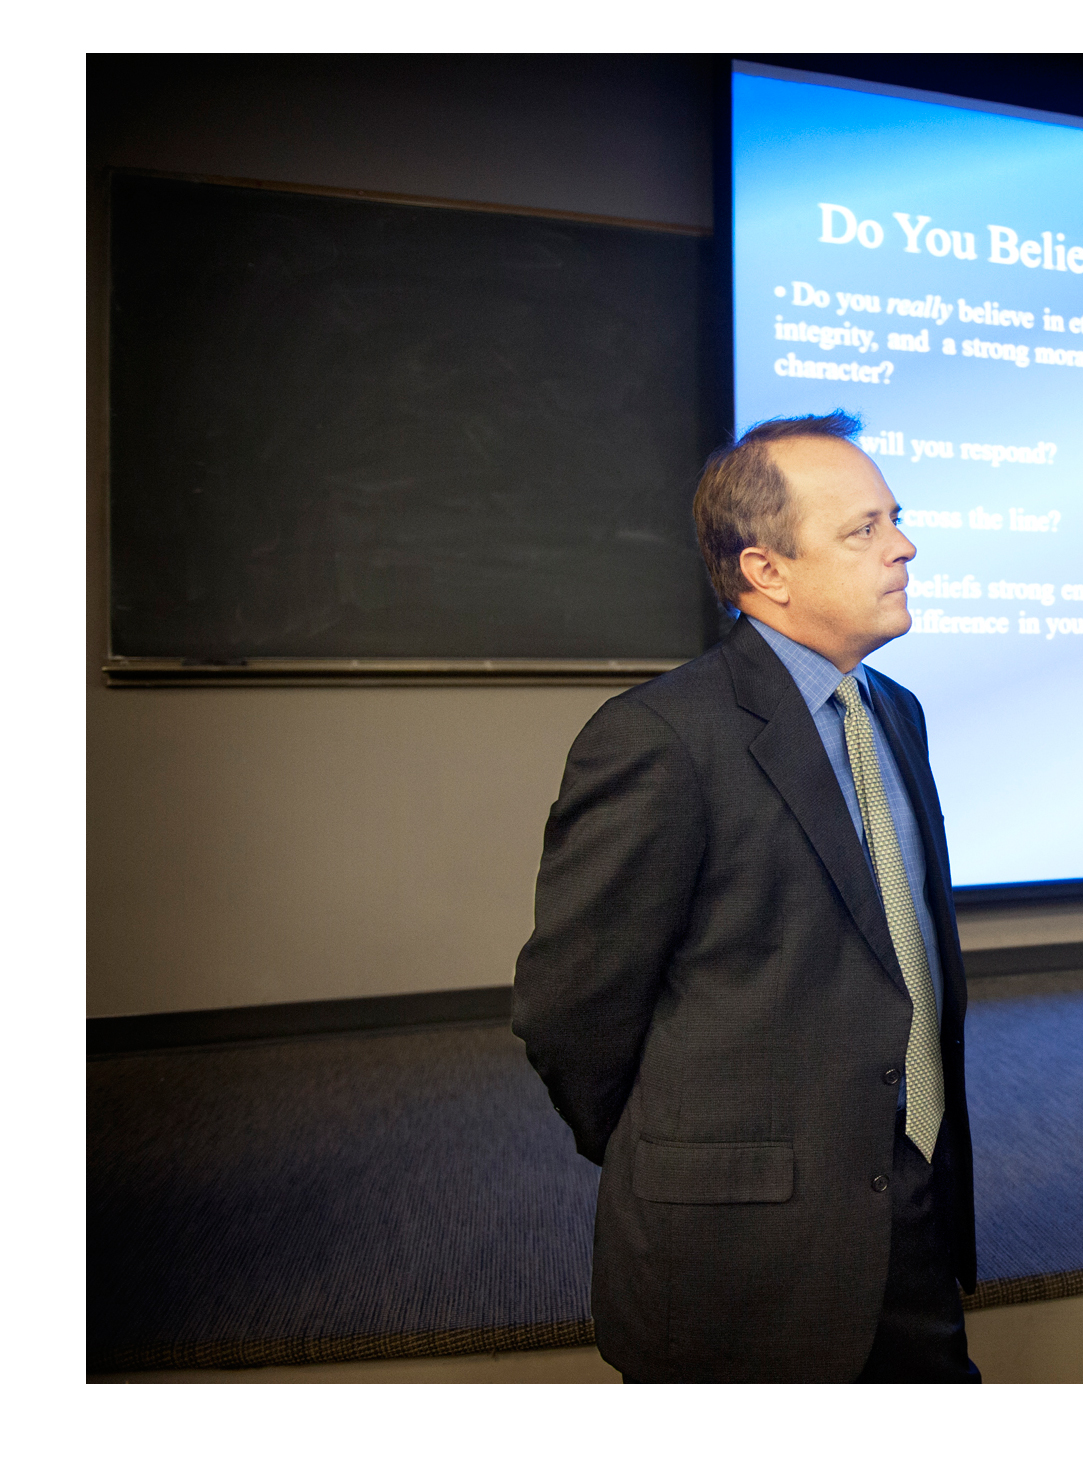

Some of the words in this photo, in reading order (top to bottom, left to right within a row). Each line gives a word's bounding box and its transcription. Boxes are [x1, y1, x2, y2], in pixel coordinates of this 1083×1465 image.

[818, 202, 884, 249] Do
[892, 212, 978, 261] You
[792, 282, 830, 308] Do
[836, 291, 881, 316] you
[886, 295, 953, 325] really
[958, 299, 1034, 329] believe
[1043, 308, 1065, 332] in
[774, 317, 879, 352] integrity,
[888, 329, 930, 353] and
[942, 338, 956, 354] a
[962, 339, 1029, 369] strong
[774, 353, 894, 385] character?
[859, 430, 905, 456] will
[910, 439, 954, 462] you
[961, 441, 1057, 467] respond?
[904, 509, 963, 528] cross
[968, 506, 1003, 530] the
[1009, 507, 1061, 533] line?
[909, 573, 982, 599] beliefs
[988, 580, 1055, 606] strong
[1019, 613, 1040, 634] in
